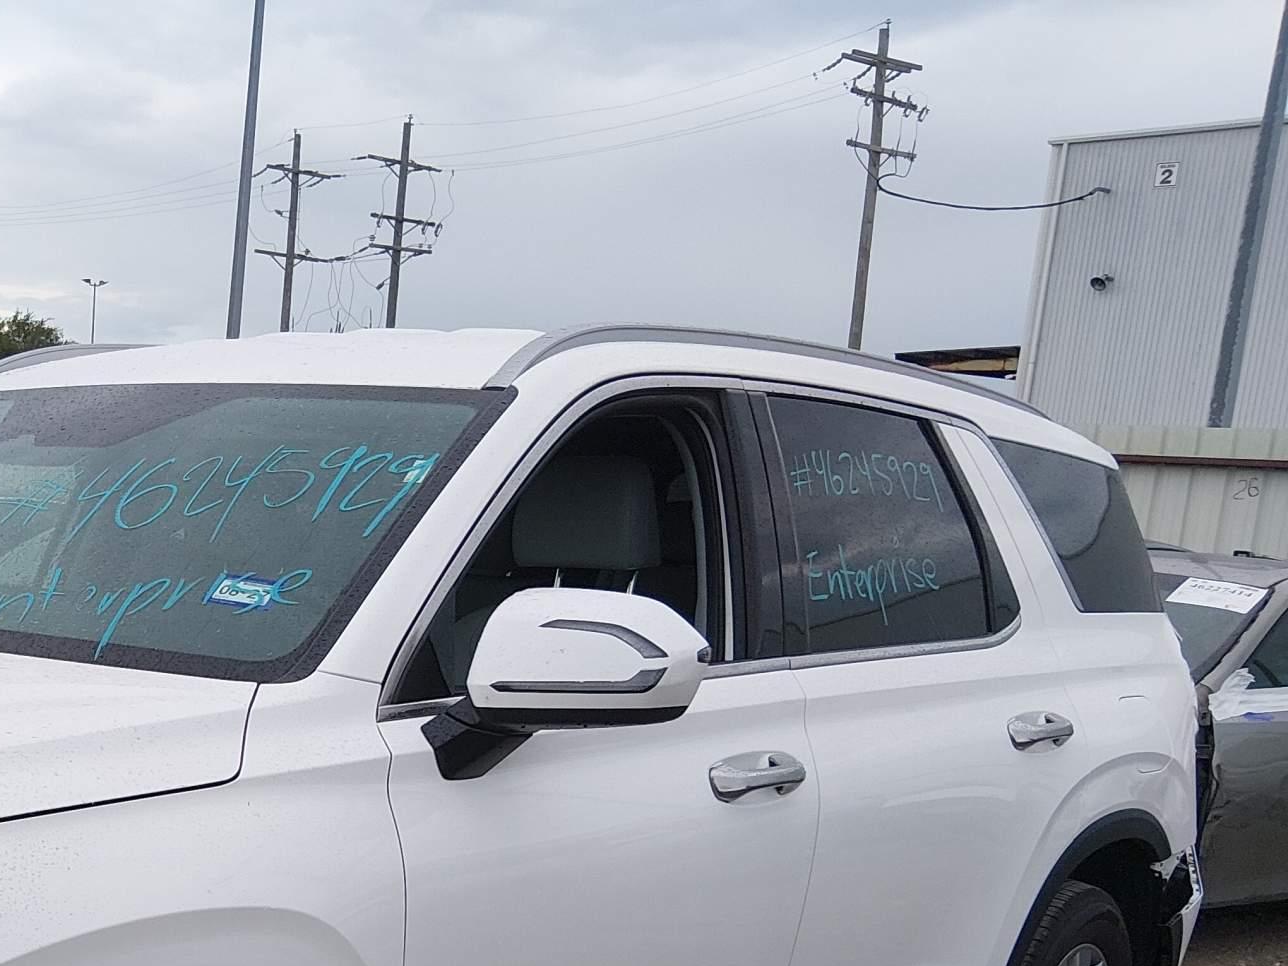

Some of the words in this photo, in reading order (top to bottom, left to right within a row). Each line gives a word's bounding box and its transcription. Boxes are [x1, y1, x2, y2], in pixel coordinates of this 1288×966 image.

[1159, 168, 1174, 185] 2
[0, 443, 441, 544] #46245929
[790, 449, 944, 512] #46245929
[1232, 477, 1260, 500] 26
[806, 544, 940, 626] Enterprise
